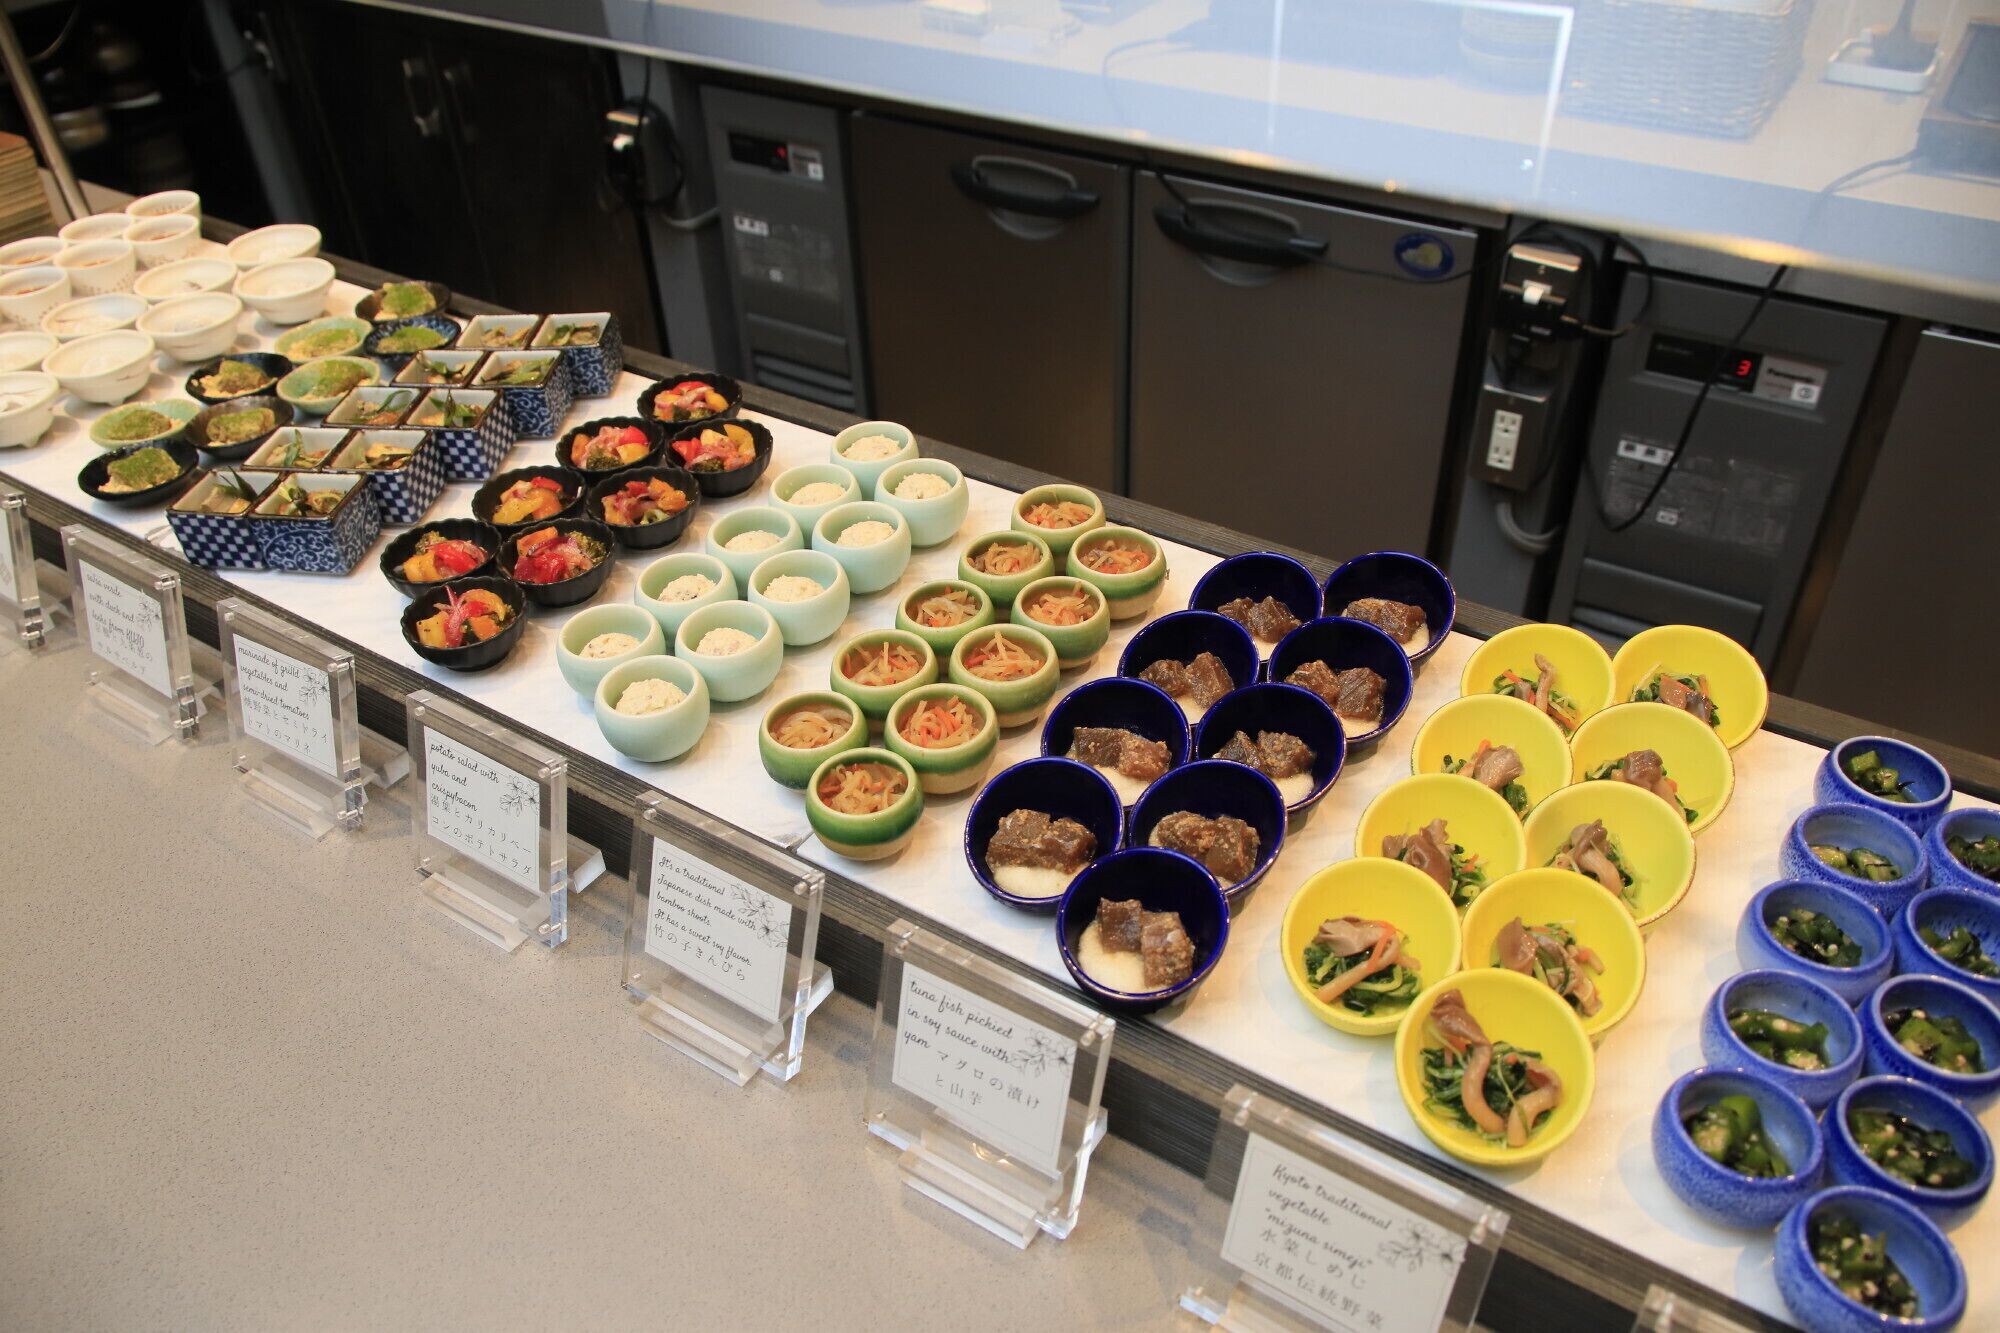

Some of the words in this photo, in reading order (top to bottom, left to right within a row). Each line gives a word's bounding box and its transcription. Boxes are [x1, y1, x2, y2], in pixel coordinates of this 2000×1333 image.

[1736, 360, 1752, 376] 3
[238, 646, 271, 666] marinade
[271, 658, 279, 675] of
[239, 665, 274, 686] vegetables
[274, 681, 289, 692] and
[279, 698, 310, 721] tomatoes
[429, 743, 456, 761] potato
[457, 756, 479, 773] salad
[480, 769, 500, 784] with
[430, 763, 451, 778] yuba
[451, 774, 467, 787] and
[432, 815, 532, 875] コンのポテトサラダ
[658, 856, 673, 871] It's
[682, 867, 726, 896] traditional
[656, 890, 686, 912] bamboo
[687, 908, 711, 926] shoots.
[657, 873, 693, 899] Japanese
[694, 893, 713, 908] dish
[713, 905, 736, 921] made
[737, 917, 757, 931] with
[654, 908, 666, 920] It
[665, 913, 679, 928] has
[688, 928, 712, 945] sweet
[712, 940, 725, 956] soy
[910, 980, 937, 1003] tuna
[937, 994, 964, 1016] fish
[904, 1030, 931, 1049] yam
[907, 1007, 921, 1020] in
[922, 1015, 942, 1036] soy
[945, 1026, 979, 1048] sauce
[981, 1044, 1010, 1064] with
[937, 1050, 1040, 1110] マグロの漬け
[1268, 1189, 1329, 1225] vegetable
[1272, 1163, 1311, 1191] Kyoto
[1314, 1184, 1393, 1231] traditional
